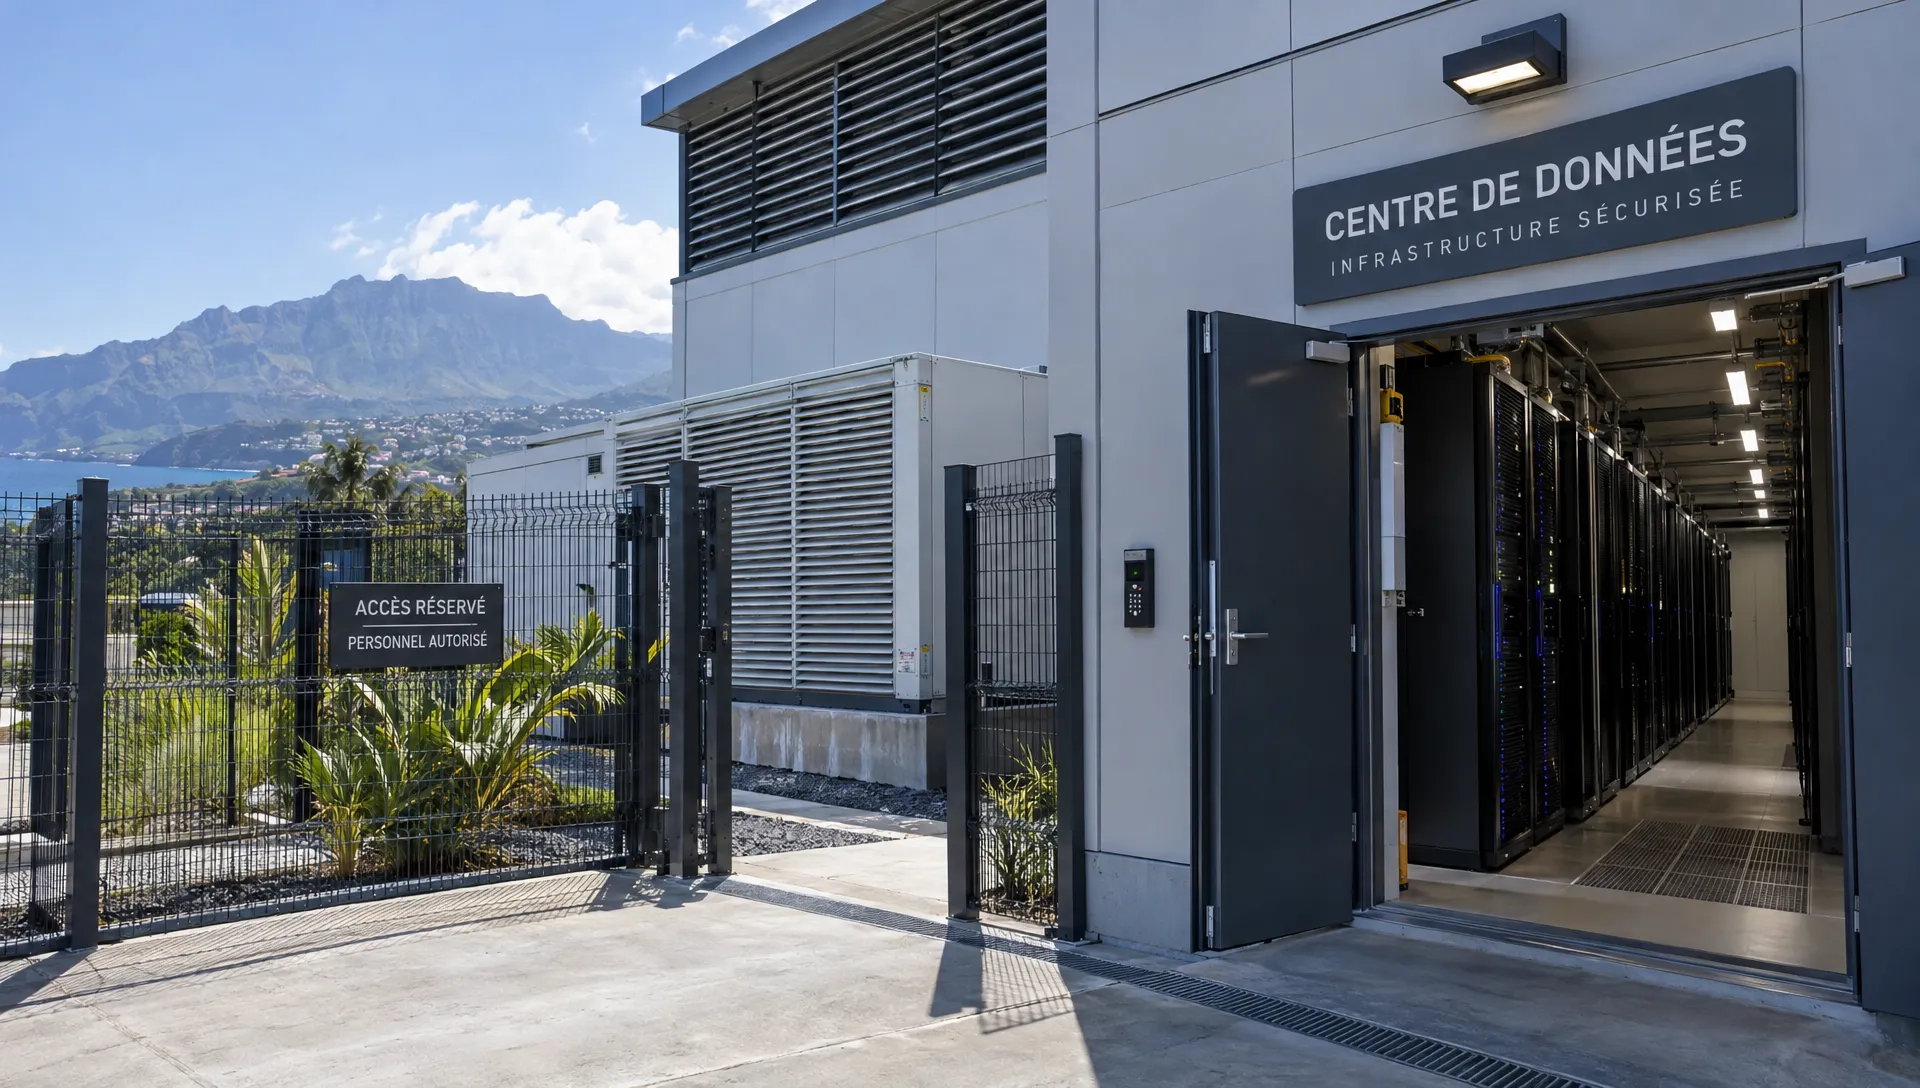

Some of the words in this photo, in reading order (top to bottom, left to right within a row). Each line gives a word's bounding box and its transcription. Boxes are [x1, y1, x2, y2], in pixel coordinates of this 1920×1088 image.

[1325, 184, 1458, 242] CENTRE
[1472, 170, 1521, 213] DE
[1535, 118, 1748, 199] DONNÉES
[1331, 216, 1561, 277] INFRASTRUCTURE
[1578, 179, 1744, 228] SÉCURISÉE
[355, 596, 411, 616] ACCÈS
[416, 596, 486, 615] RÉSERVÉ
[348, 634, 426, 650] PERSONNEL
[428, 630, 488, 648] AUTORISÉ
